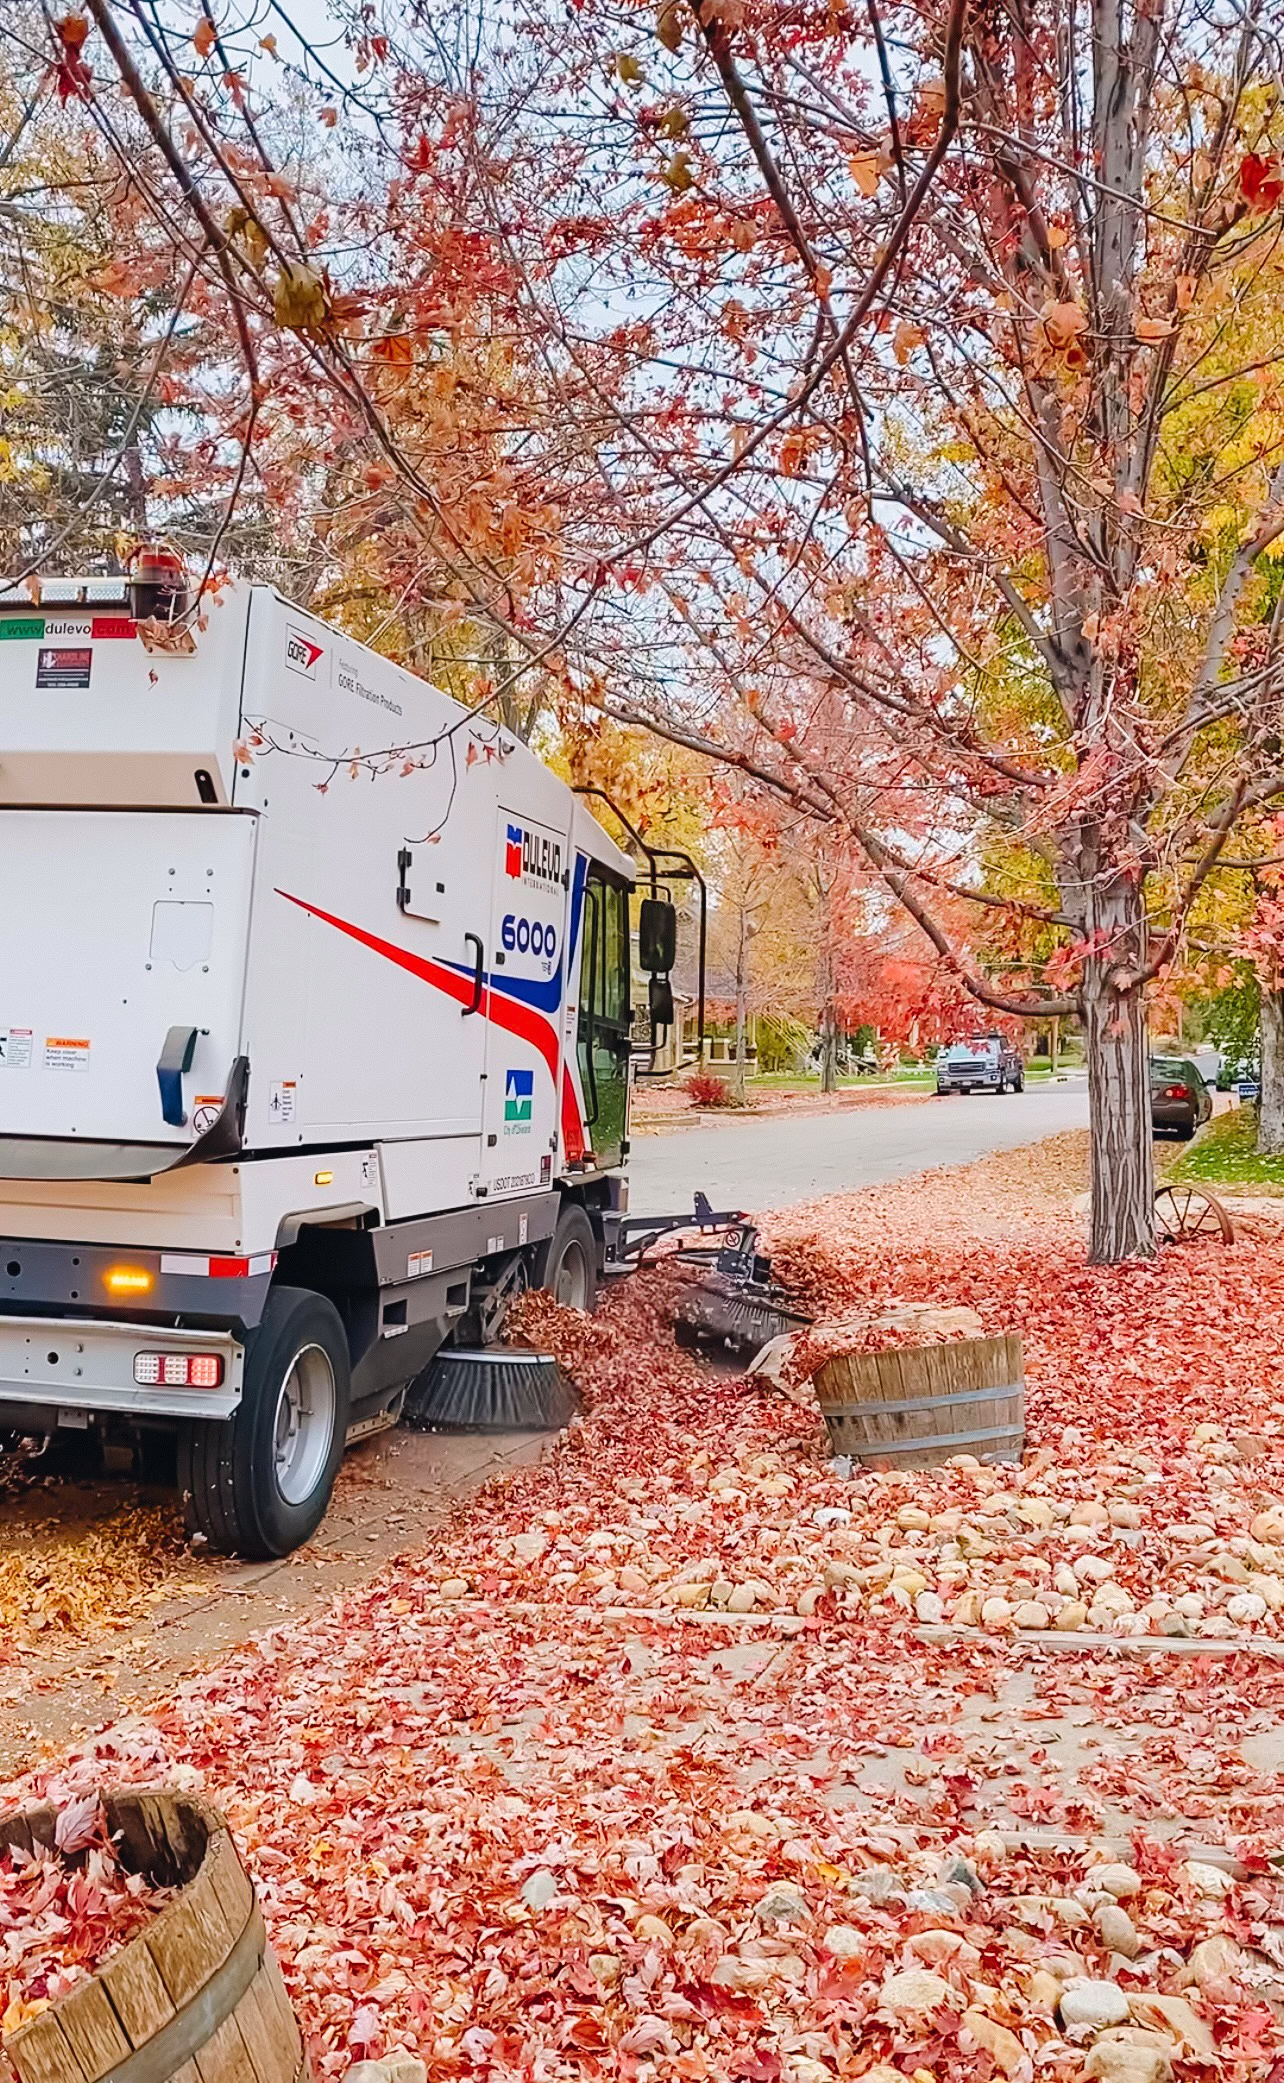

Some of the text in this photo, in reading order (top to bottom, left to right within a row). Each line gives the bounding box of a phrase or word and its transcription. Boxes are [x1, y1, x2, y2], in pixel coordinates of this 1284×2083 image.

[287, 640, 307, 665] GORE
[338, 673, 402, 717] GORE Filtration Products
[523, 831, 560, 883] DULEVO
[522, 878, 560, 896] INTERNATIONAL
[501, 914, 556, 958] 6000
[493, 1176, 511, 1191] USDOT
